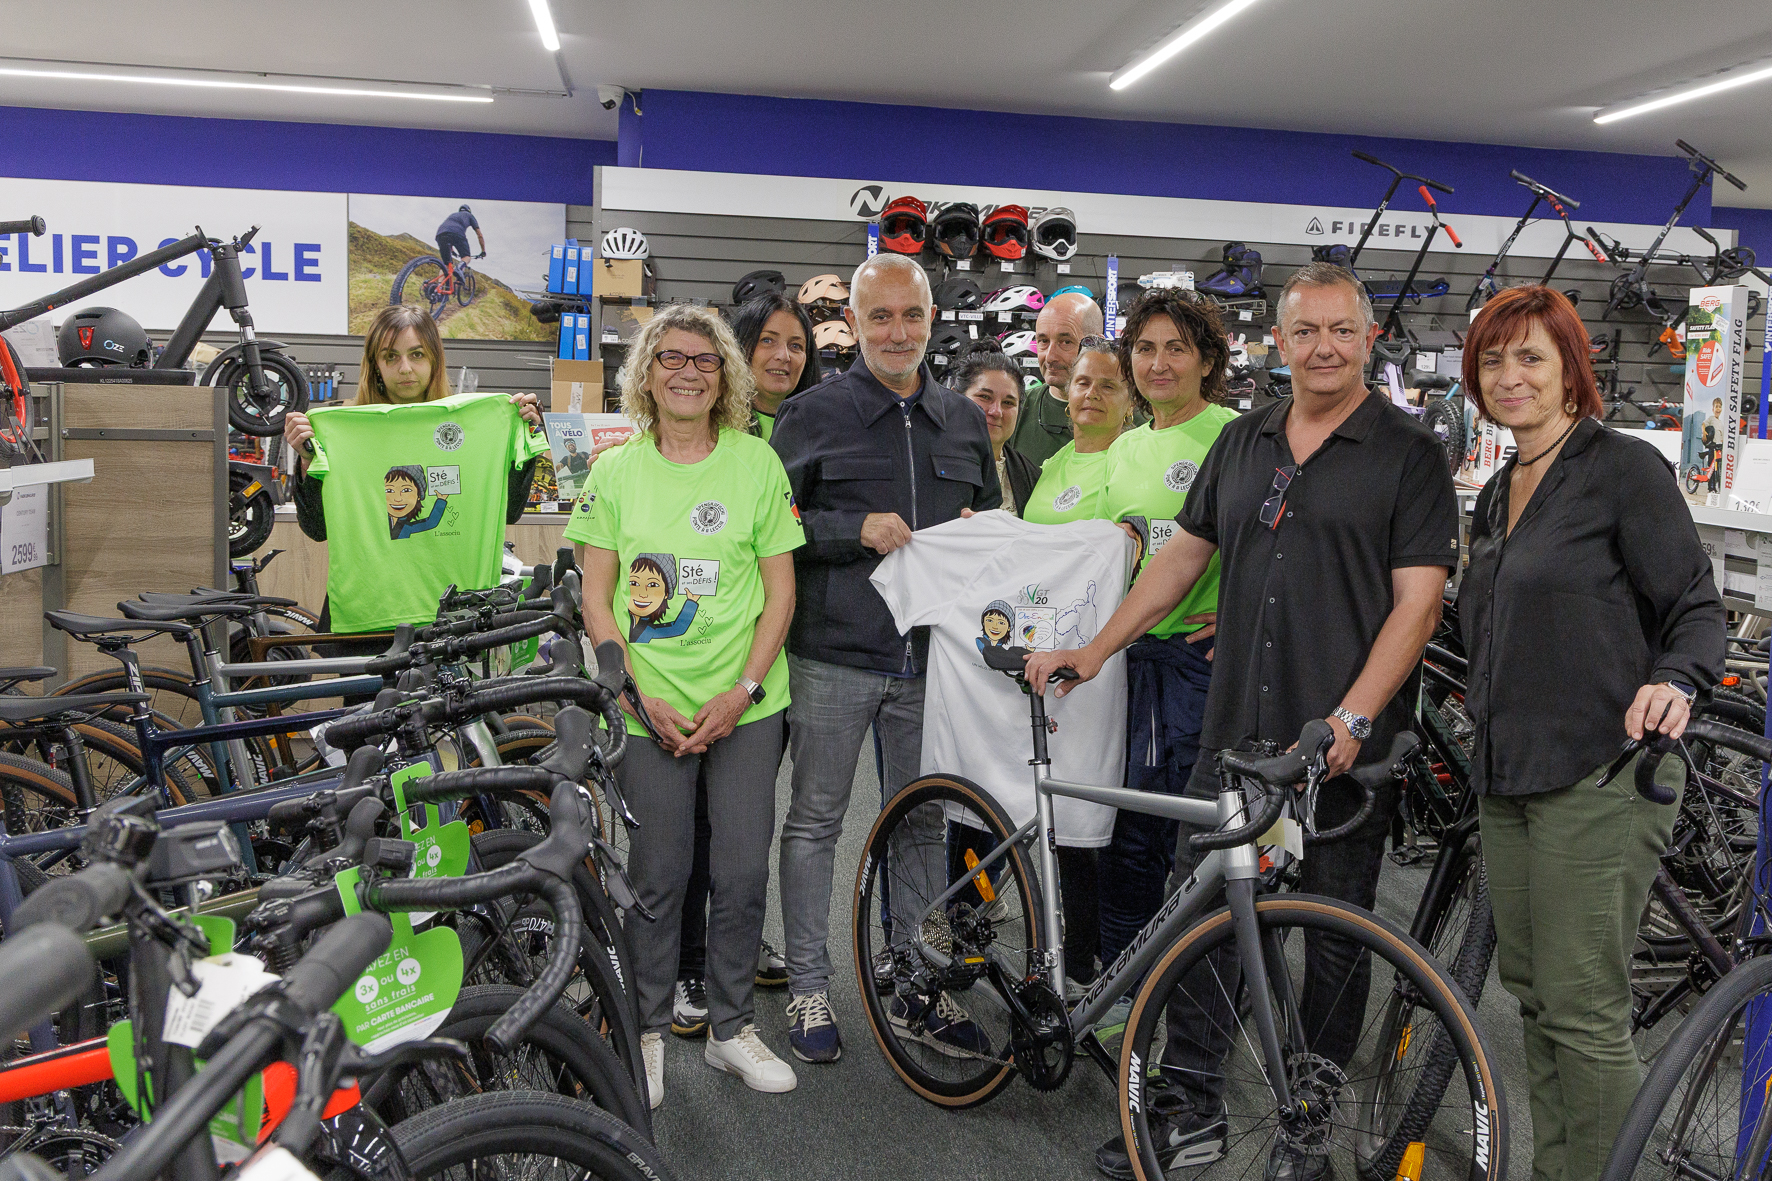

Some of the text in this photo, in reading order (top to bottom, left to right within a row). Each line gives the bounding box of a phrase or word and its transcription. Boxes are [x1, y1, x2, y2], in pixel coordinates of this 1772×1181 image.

[1105, 269, 1118, 331] INTERSPORT
[1699, 300, 1720, 308] BERG
[103, 340, 125, 353] OZE
[1725, 318, 1743, 489] BERG BIKY SAFETY FLAG
[549, 422, 572, 430] TOUS
[562, 428, 583, 437] VÉLO
[1484, 424, 1494, 467] BERG BI
[430, 470, 447, 483] Sté
[1152, 525, 1172, 539] Sté
[682, 564, 703, 578] Sté
[692, 577, 712, 585] DÉFIS
[284, 610, 314, 626] MAVIC
[426, 835, 436, 848] EN
[429, 852, 439, 861] 4x
[860, 851, 872, 897] MAVIC
[366, 946, 409, 974] AYEZ EN
[360, 966, 417, 996] 3x ou 4x
[366, 985, 416, 1012] sans frais
[356, 1021, 370, 1034] PAR
[371, 1010, 396, 1026] CARTE
[395, 993, 435, 1015] BANCAIRE
[1128, 1051, 1141, 1113] MAVIC
[1475, 1100, 1489, 1172] MAVIC
